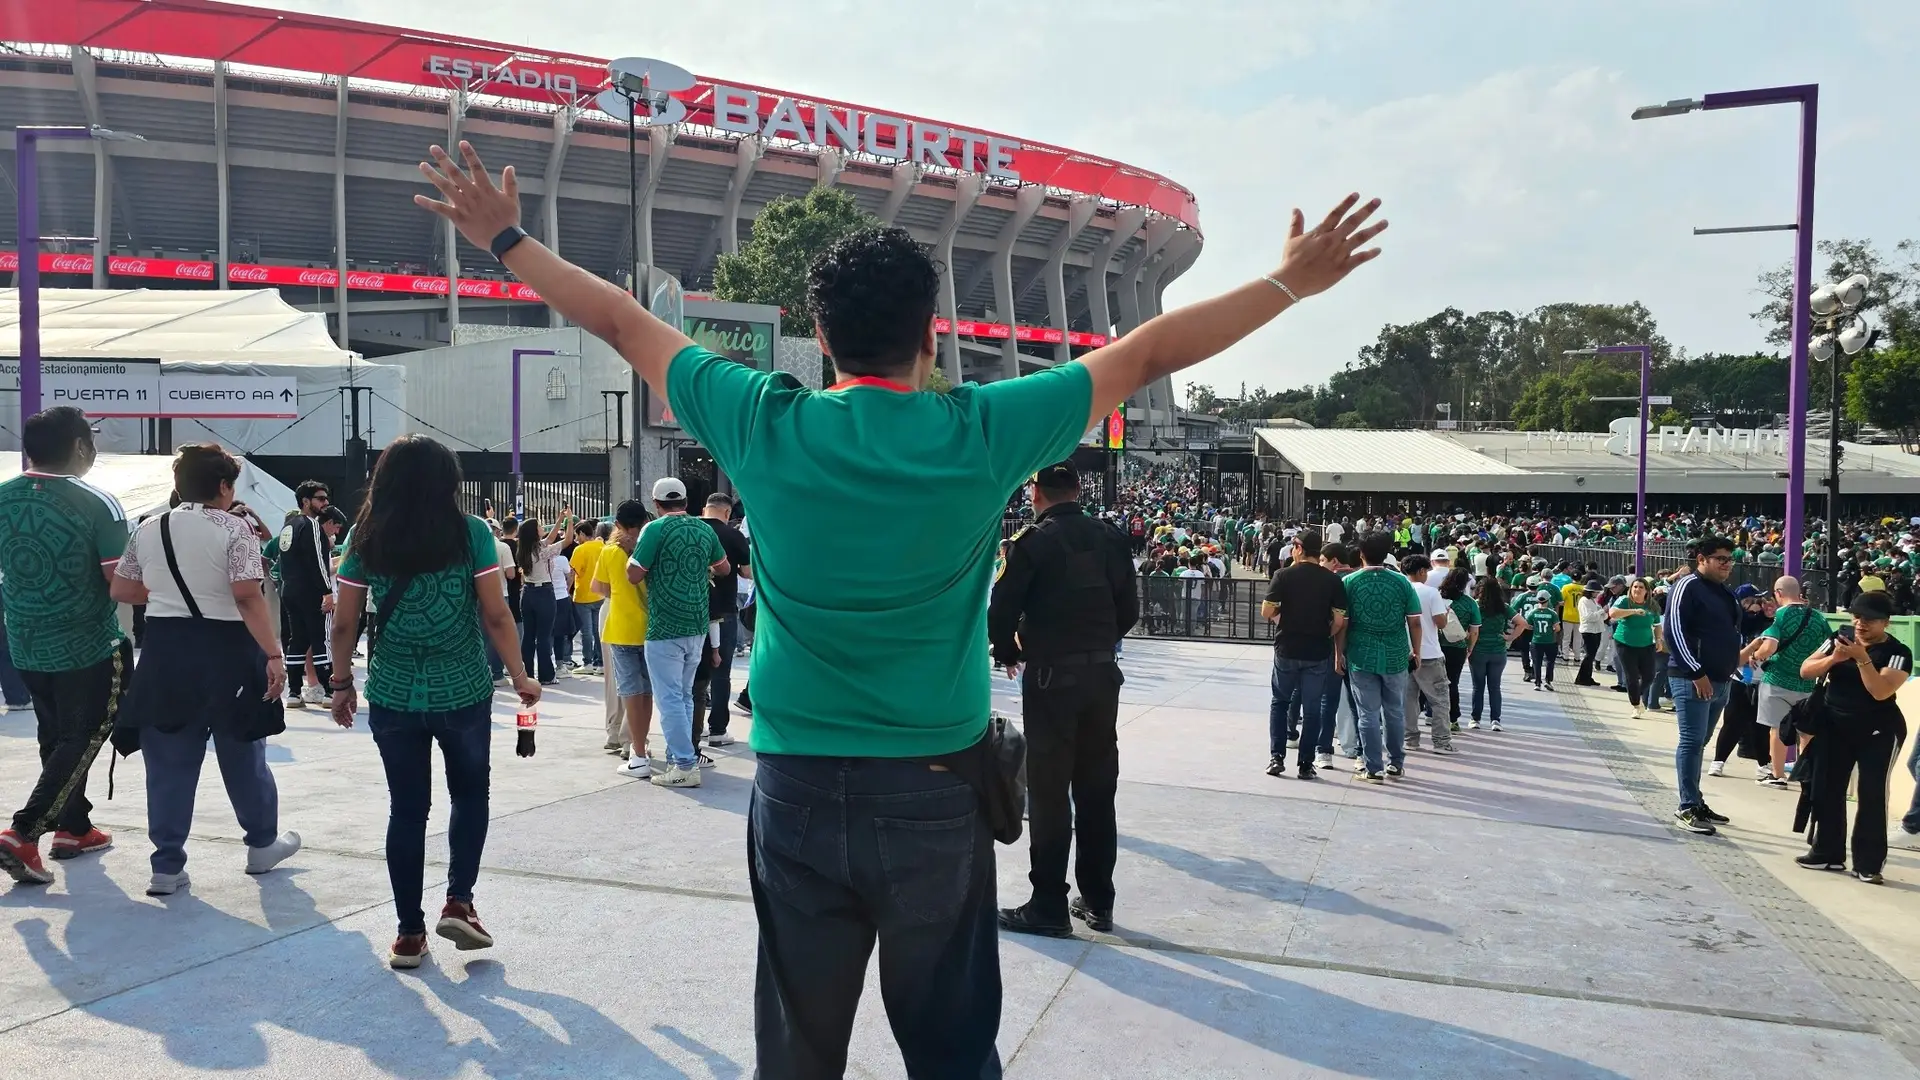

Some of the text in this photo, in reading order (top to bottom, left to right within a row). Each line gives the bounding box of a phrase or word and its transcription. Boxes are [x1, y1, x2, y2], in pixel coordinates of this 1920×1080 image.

[429, 54, 1023, 180] ESTADIO BANORTE
[40, 363, 126, 375] Estacionamiento
[54, 389, 147, 400] PUERTA 11
[168, 390, 274, 400] CUBIERTO AA
[1659, 425, 1790, 453] BANORT
[1537, 620, 1549, 633] 17
